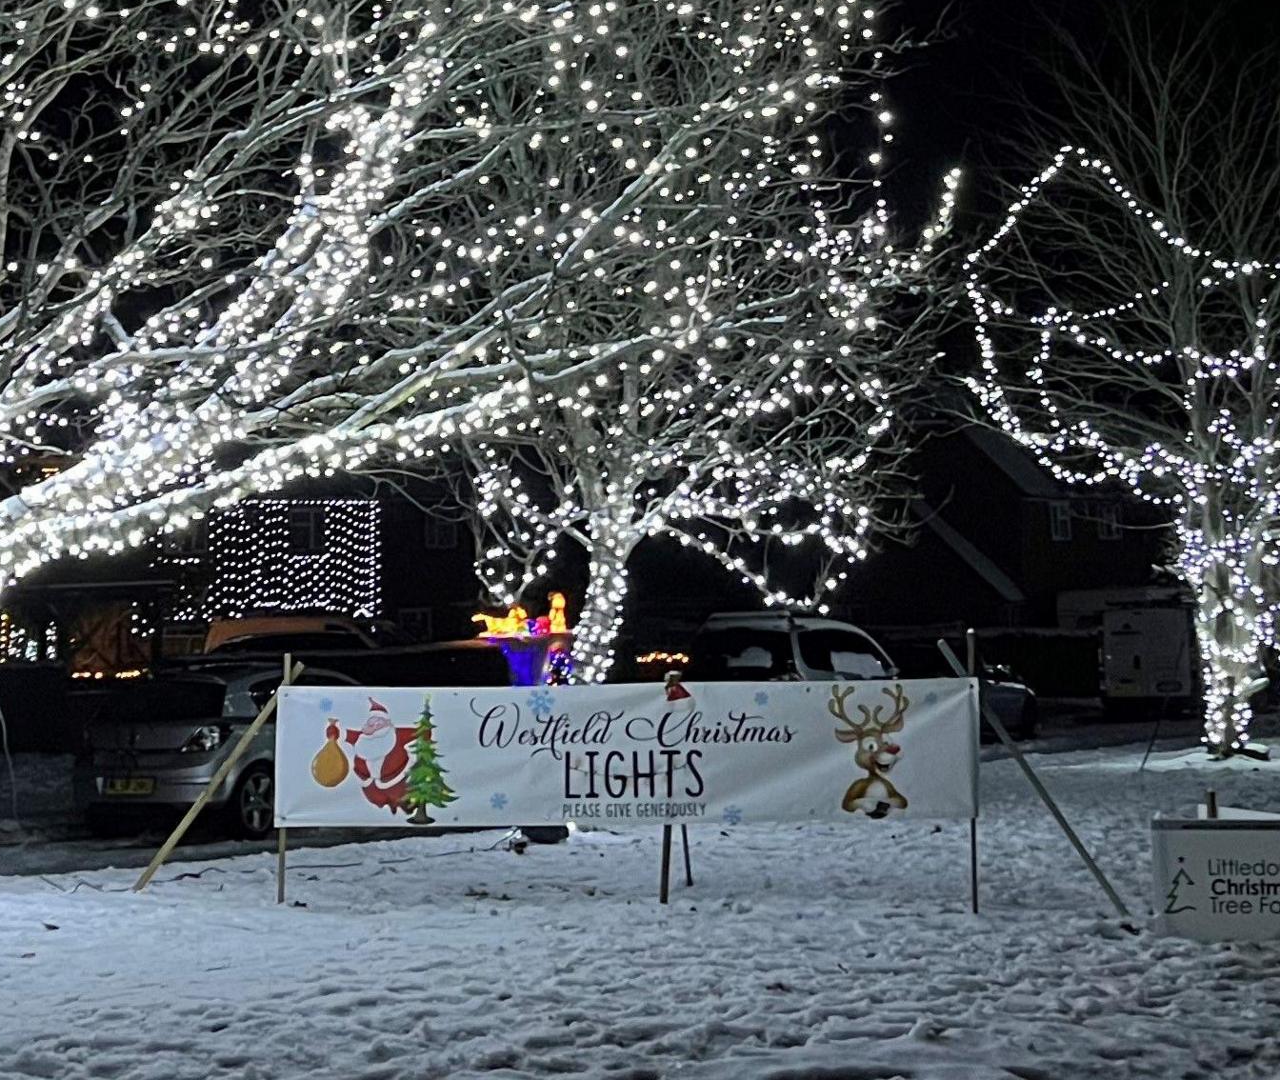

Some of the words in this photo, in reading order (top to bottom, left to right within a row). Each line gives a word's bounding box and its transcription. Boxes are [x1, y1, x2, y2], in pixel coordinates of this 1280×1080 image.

[470, 697, 624, 760] Westfield
[625, 710, 798, 747] Christmas
[564, 749, 704, 799] LIGHTS
[562, 803, 601, 819] PLEASE
[605, 802, 632, 818] GIVE
[636, 801, 706, 819] GENEROUSLY
[1210, 896, 1252, 915] Tree
